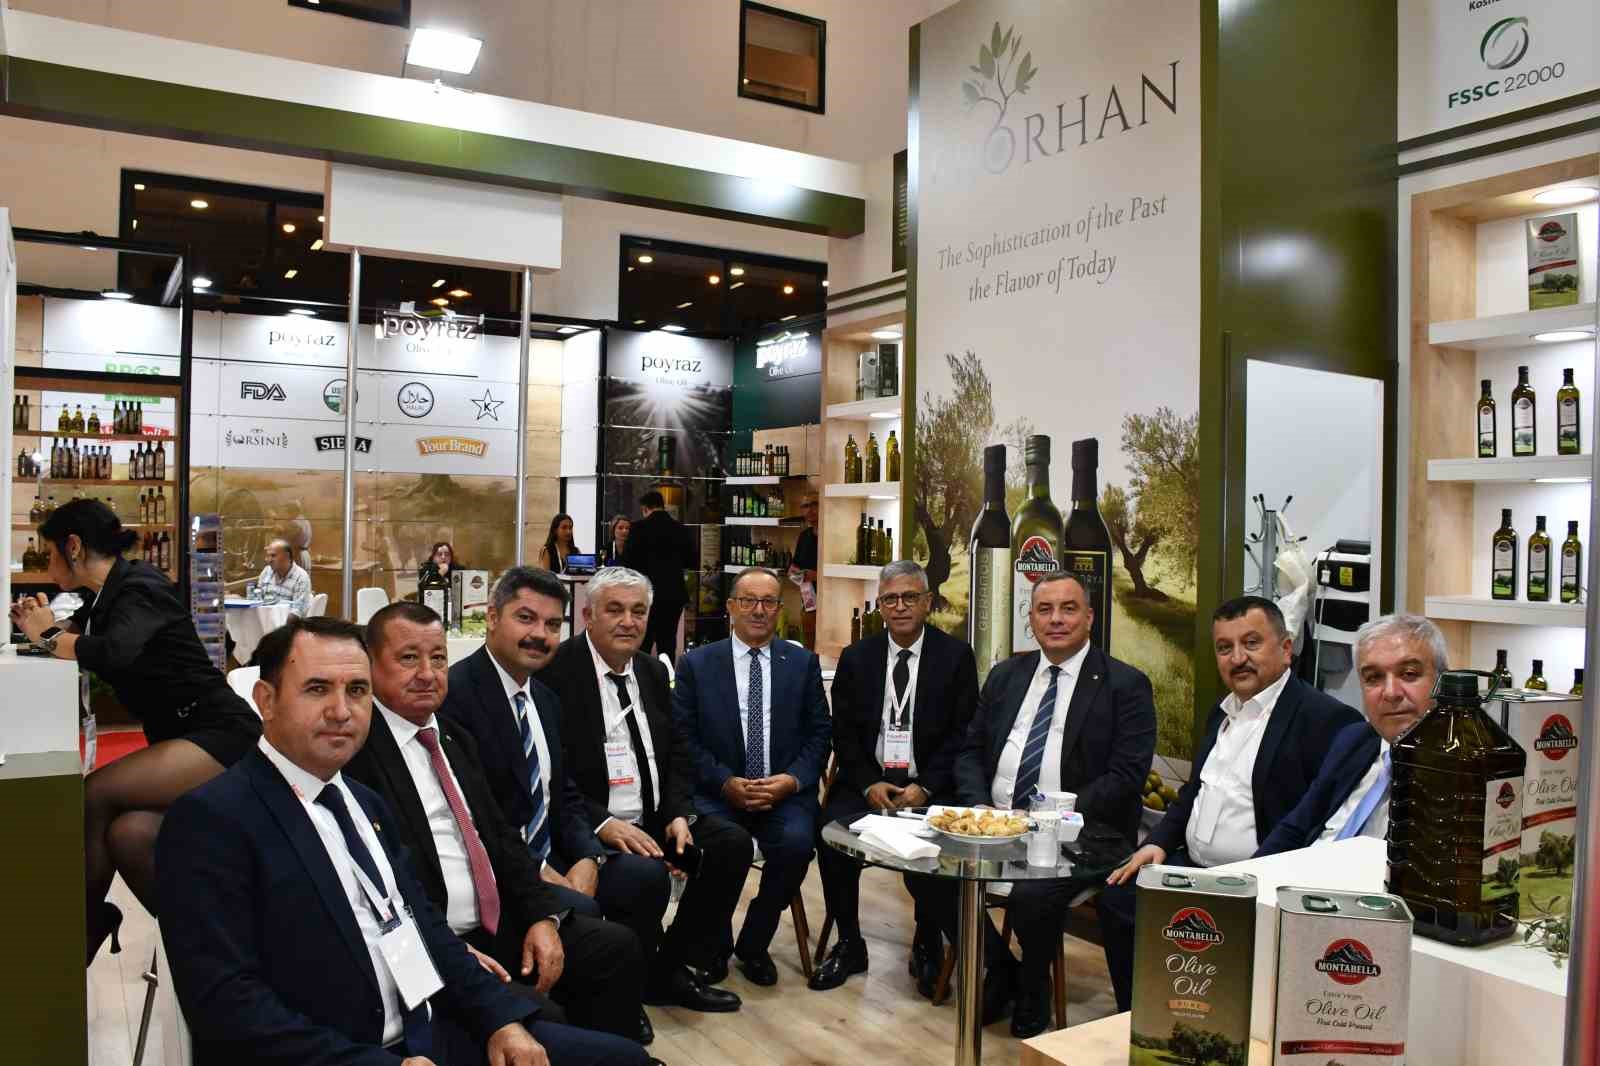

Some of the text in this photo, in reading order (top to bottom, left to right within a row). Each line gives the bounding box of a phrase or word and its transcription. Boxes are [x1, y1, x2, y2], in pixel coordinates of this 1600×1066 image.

[1448, 62, 1565, 108] FSSC 22000
[937, 194, 1167, 270] The Sophistication of the Past
[969, 250, 1117, 302] the Flavor of Today
[384, 318, 477, 341] poyraz
[642, 355, 703, 373] poyraz
[241, 381, 287, 401] FDA
[320, 437, 368, 452] SIEA
[422, 440, 485, 456] Your Brand
[1017, 562, 1056, 572] MONTABELLA
[1166, 929, 1220, 943] MONTABELLA
[1165, 953, 1217, 976] Olive
[1318, 961, 1378, 977] MONTABELLA
[1173, 976, 1213, 996] Oil
[1305, 999, 1388, 1020] Olive Oil
